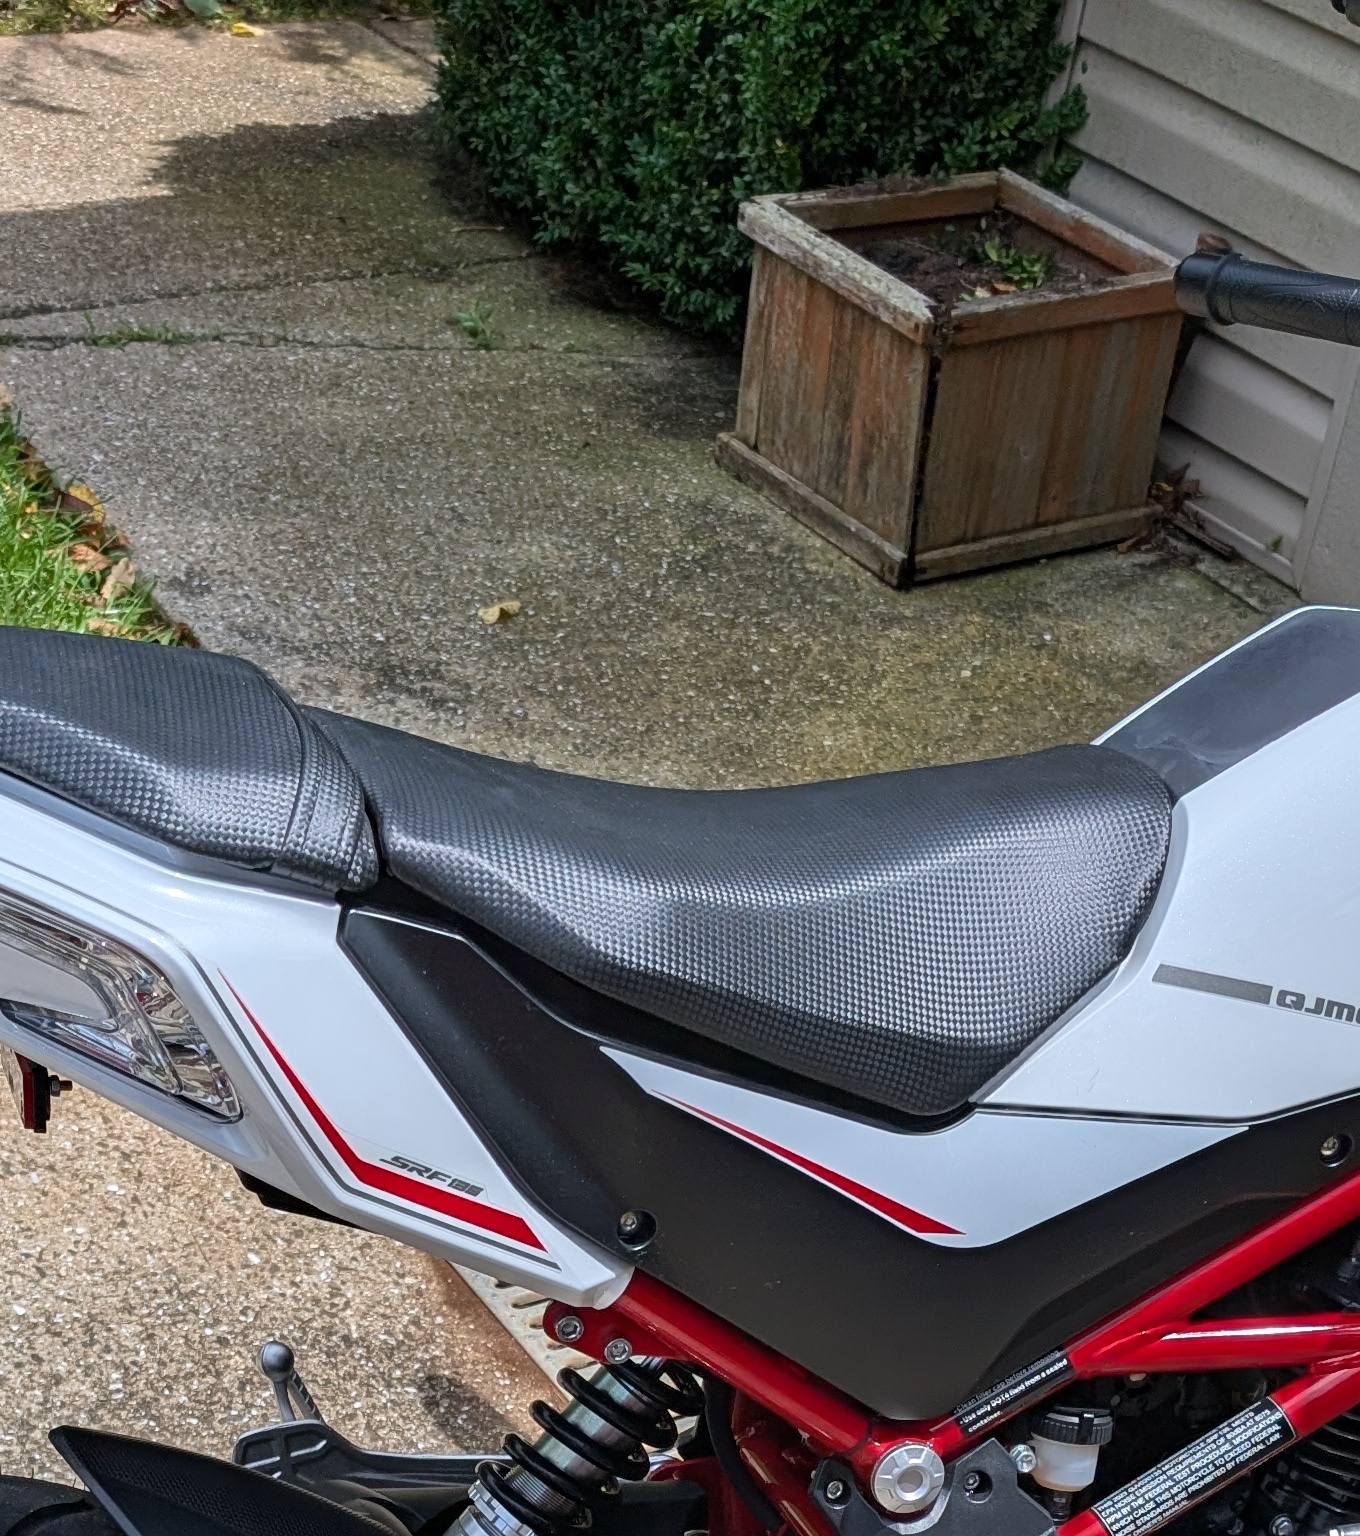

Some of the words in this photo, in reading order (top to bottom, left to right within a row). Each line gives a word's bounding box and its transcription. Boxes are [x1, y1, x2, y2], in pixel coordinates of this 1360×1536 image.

[963, 1413, 976, 1423] Use
[976, 1405, 991, 1415] only
[1009, 1383, 1025, 1395] fluid
[1025, 1375, 1041, 1387] from
[1046, 1359, 1067, 1375] sealed
[969, 1411, 1002, 1432] container.
[1097, 1501, 1113, 1511] THIS
[1231, 1412, 1254, 1427] MEETS
[1101, 1507, 1116, 1517] EPA
[1115, 1494, 1136, 1509] NOISE
[1135, 1474, 1167, 1496] EMISSION
[1166, 1443, 1216, 1476] REQUIREMENTS
[1216, 1437, 1225, 1445] OF
[1106, 1512, 1122, 1524] RPM
[1121, 1505, 1131, 1515] BY
[1131, 1497, 1145, 1508] THE
[1144, 1480, 1175, 1500] FEDERAL
[1174, 1468, 1190, 1481] TEST
[1232, 1412, 1282, 1445] MODIFICATIONS
[1111, 1515, 1134, 1531] WHICH
[1133, 1501, 1156, 1517] CAUSE
[1155, 1491, 1171, 1503] THIS
[1170, 1464, 1214, 1494] MOTORCYCLE
[1214, 1458, 1225, 1466] TO
[1224, 1441, 1251, 1461] EXCEED
[1251, 1424, 1281, 1444] FEDERAL
[1136, 1500, 1174, 1526] STANDARDS
[1175, 1491, 1188, 1502] ARE
[1188, 1467, 1226, 1493] PROHIBITED
[1226, 1460, 1235, 1470] BY
[1236, 1443, 1266, 1463] FEDERAL
[1265, 1433, 1282, 1445] LAW.
[1133, 1516, 1162, 1536] OWNER'S
